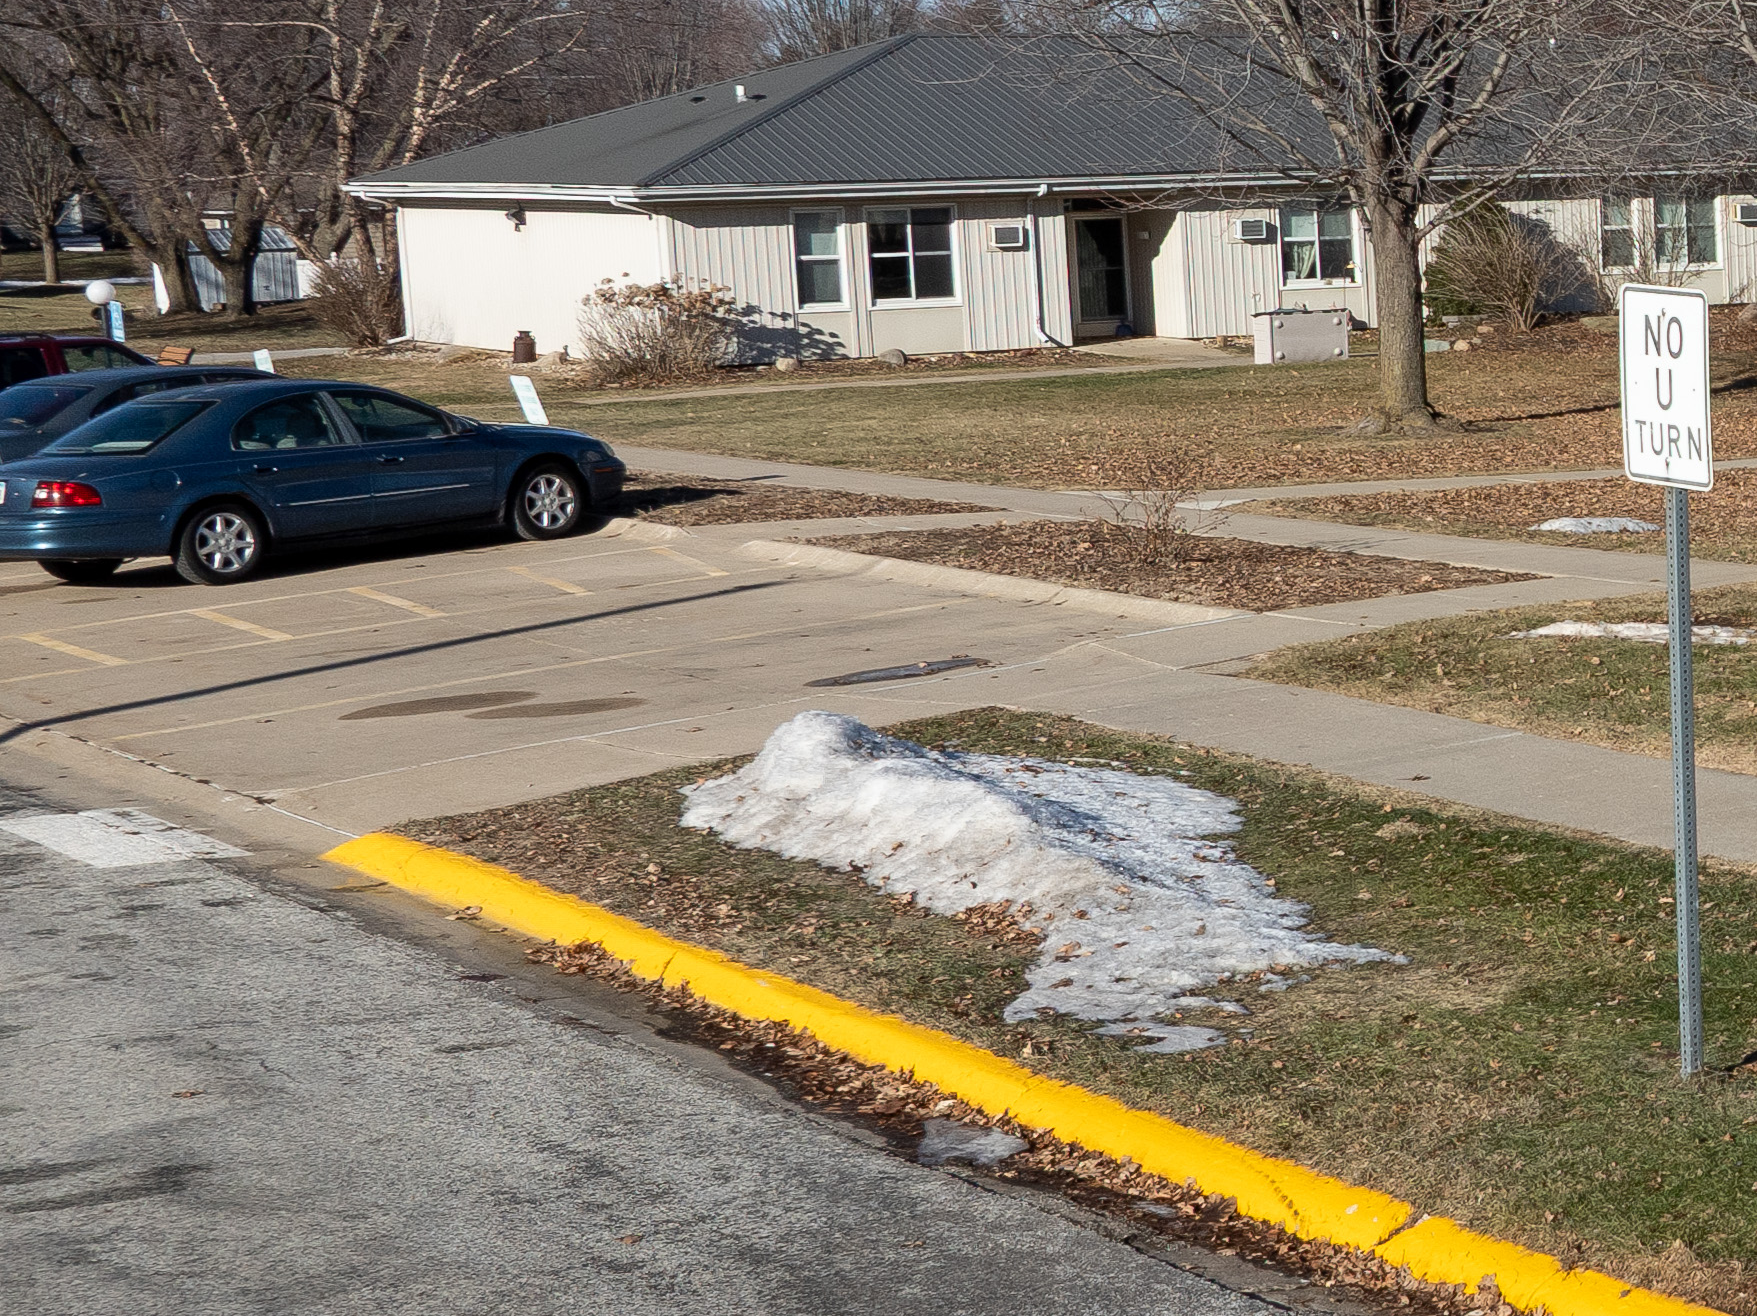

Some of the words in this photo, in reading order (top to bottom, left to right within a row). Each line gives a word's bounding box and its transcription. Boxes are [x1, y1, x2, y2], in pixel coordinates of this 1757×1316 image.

[1644, 314, 1683, 359] NO
[1656, 367, 1673, 411] U
[1634, 419, 1703, 462] TURN
